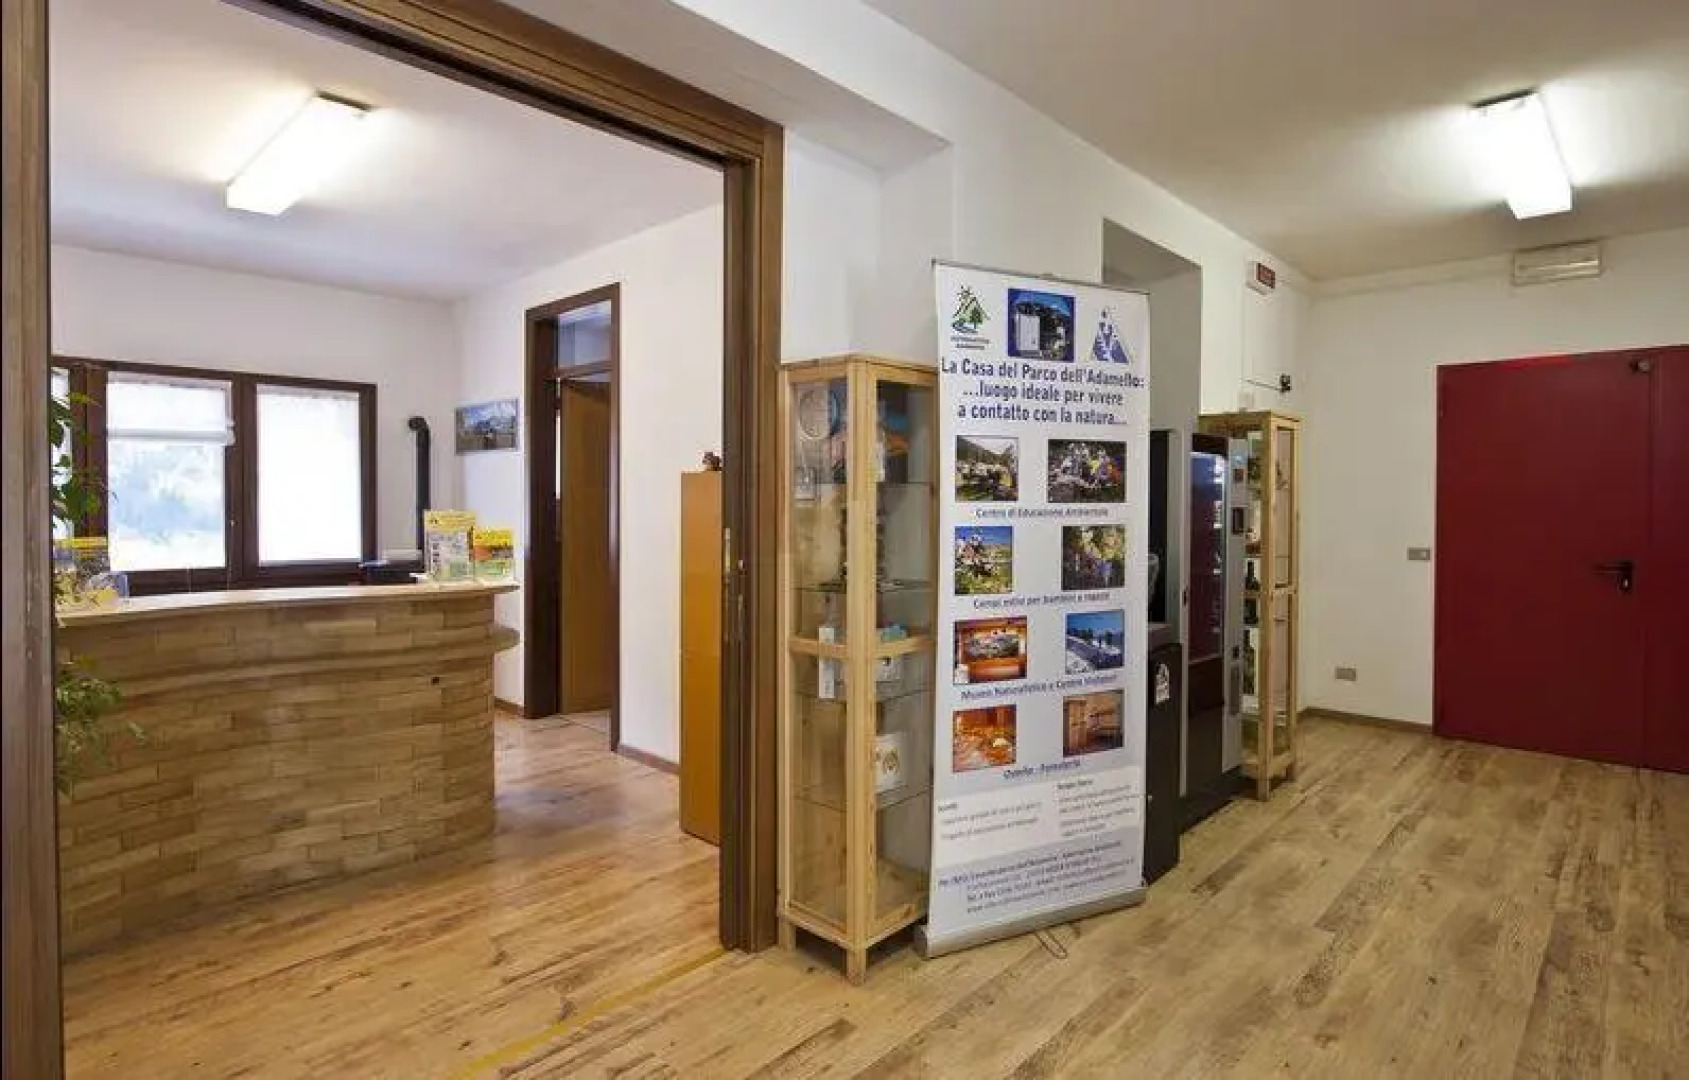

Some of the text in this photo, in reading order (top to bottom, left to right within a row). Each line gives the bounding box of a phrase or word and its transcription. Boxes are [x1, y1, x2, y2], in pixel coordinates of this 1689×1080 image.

[942, 357, 957, 374] La
[962, 358, 994, 376] Casa
[999, 362, 1018, 378] del
[1022, 364, 1057, 381] Parco
[1021, 382, 1060, 402] ideale
[1064, 389, 1085, 405] per
[1088, 388, 1123, 405] vivere
[958, 404, 966, 418] a
[971, 404, 1030, 421] contatto
[1033, 407, 1058, 423] con
[1061, 407, 1073, 422] la
